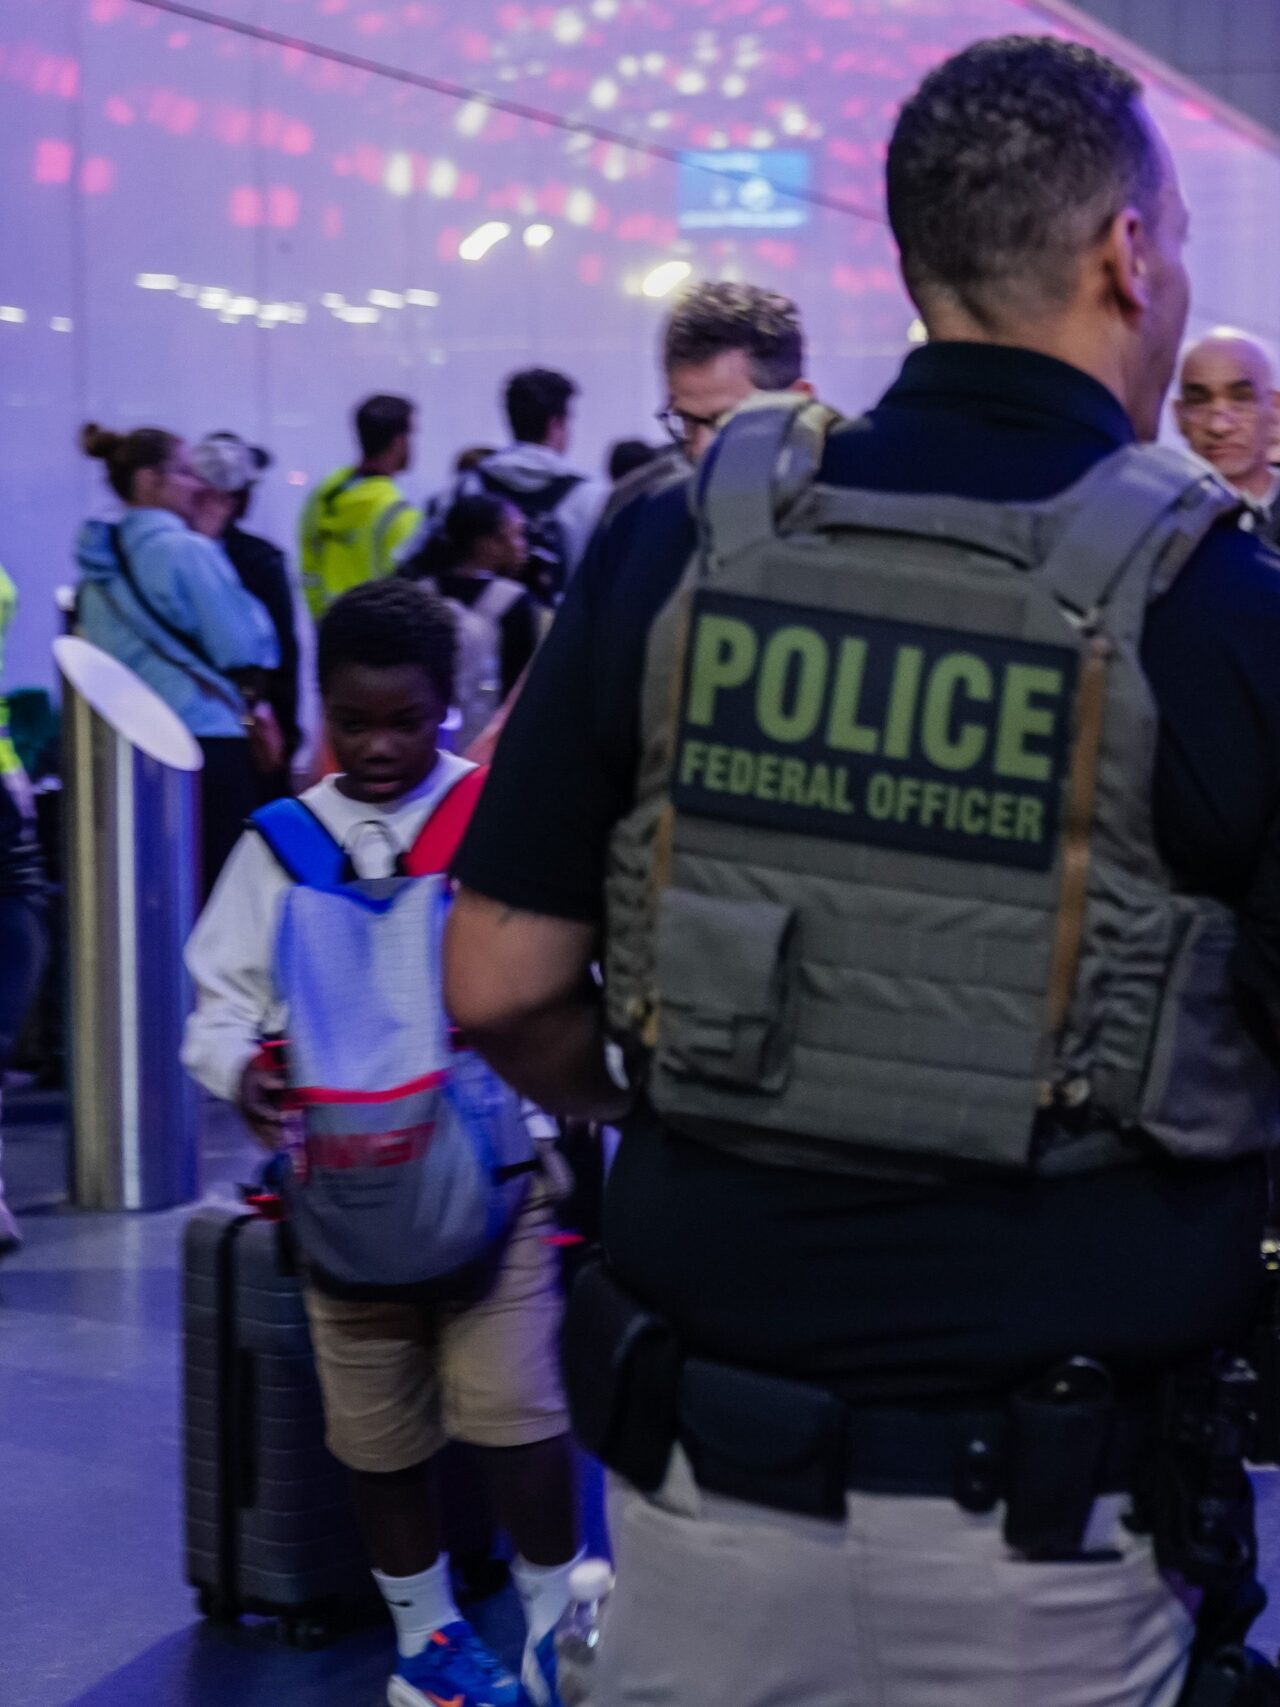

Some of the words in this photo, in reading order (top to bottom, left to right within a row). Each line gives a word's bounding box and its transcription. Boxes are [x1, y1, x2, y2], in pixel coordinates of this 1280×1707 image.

[686, 614, 1064, 782] POLICE
[679, 741, 855, 813] FEDERAL
[867, 773, 1045, 842] OFFICER
